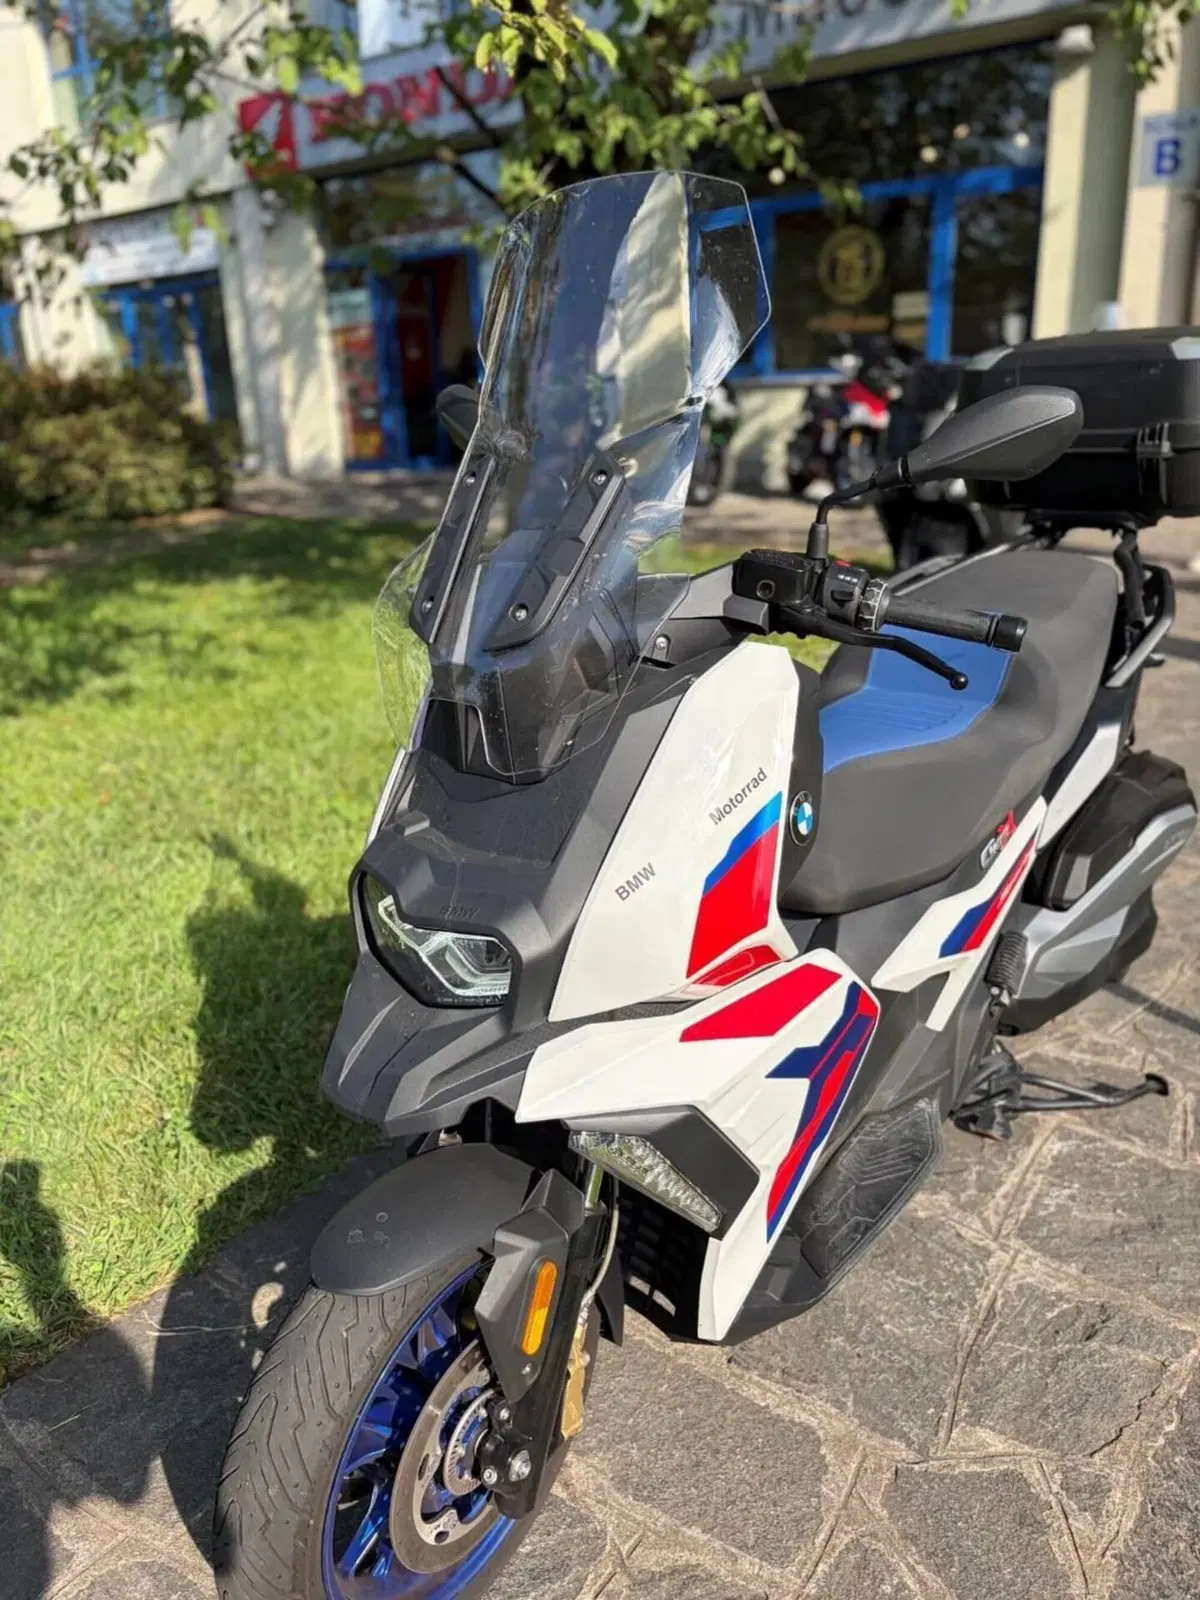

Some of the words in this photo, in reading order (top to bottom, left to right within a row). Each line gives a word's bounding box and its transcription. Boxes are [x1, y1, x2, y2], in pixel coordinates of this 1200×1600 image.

[1155, 138, 1181, 176] B
[614, 862, 657, 901] BMW
[708, 767, 768, 826] Motorrad
